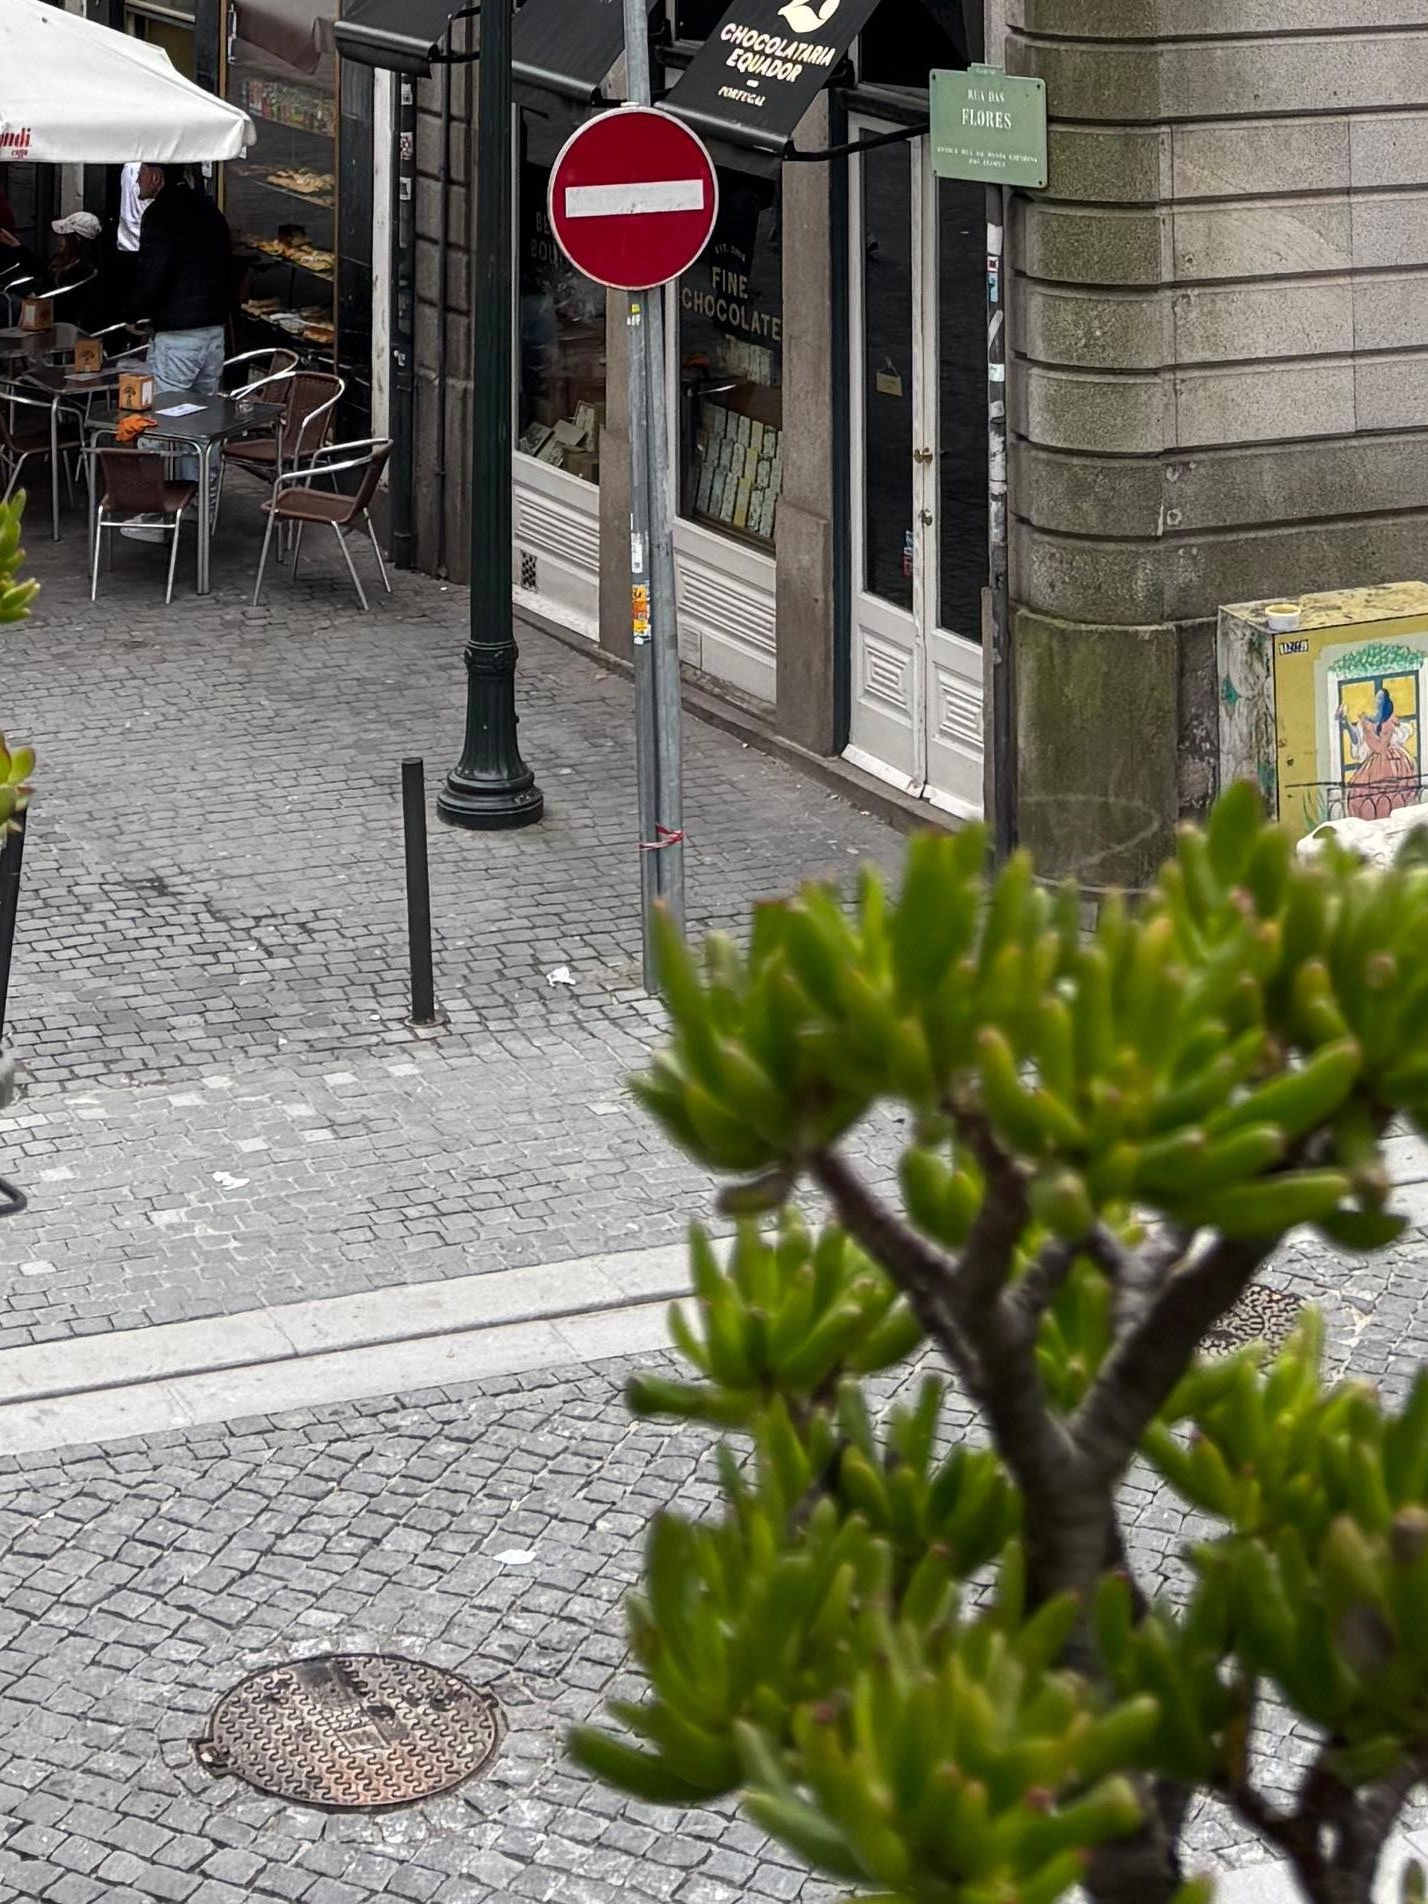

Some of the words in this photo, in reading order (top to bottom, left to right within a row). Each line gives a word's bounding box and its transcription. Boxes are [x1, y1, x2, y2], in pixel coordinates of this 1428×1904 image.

[720, 22, 836, 67] CHOCOLATARIA
[726, 47, 803, 83] EQUADOR
[967, 88, 985, 102] RUA
[988, 91, 1005, 103] DAS
[962, 108, 1012, 129] FLORES
[712, 266, 748, 299] FINE
[681, 287, 781, 342] CHOCOLATE
